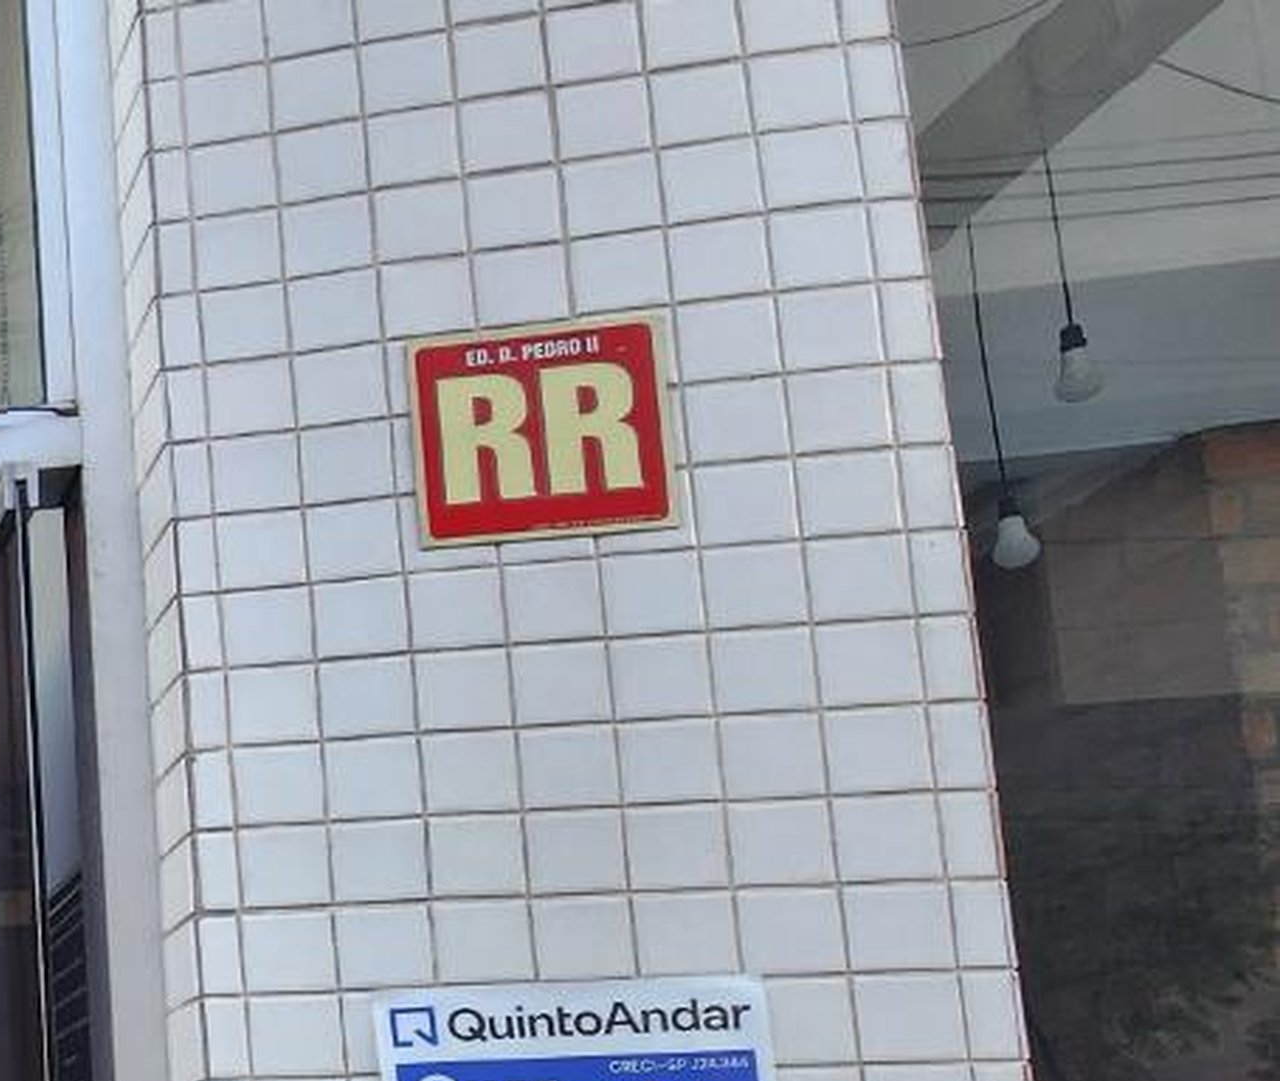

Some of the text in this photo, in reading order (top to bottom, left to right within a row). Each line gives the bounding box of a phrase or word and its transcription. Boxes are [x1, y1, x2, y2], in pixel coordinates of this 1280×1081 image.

[465, 350, 494, 367] ED.
[498, 345, 517, 363] D.
[521, 338, 583, 361] PEDRO
[435, 362, 645, 505] RR
[448, 999, 751, 1042] QuintoAndar
